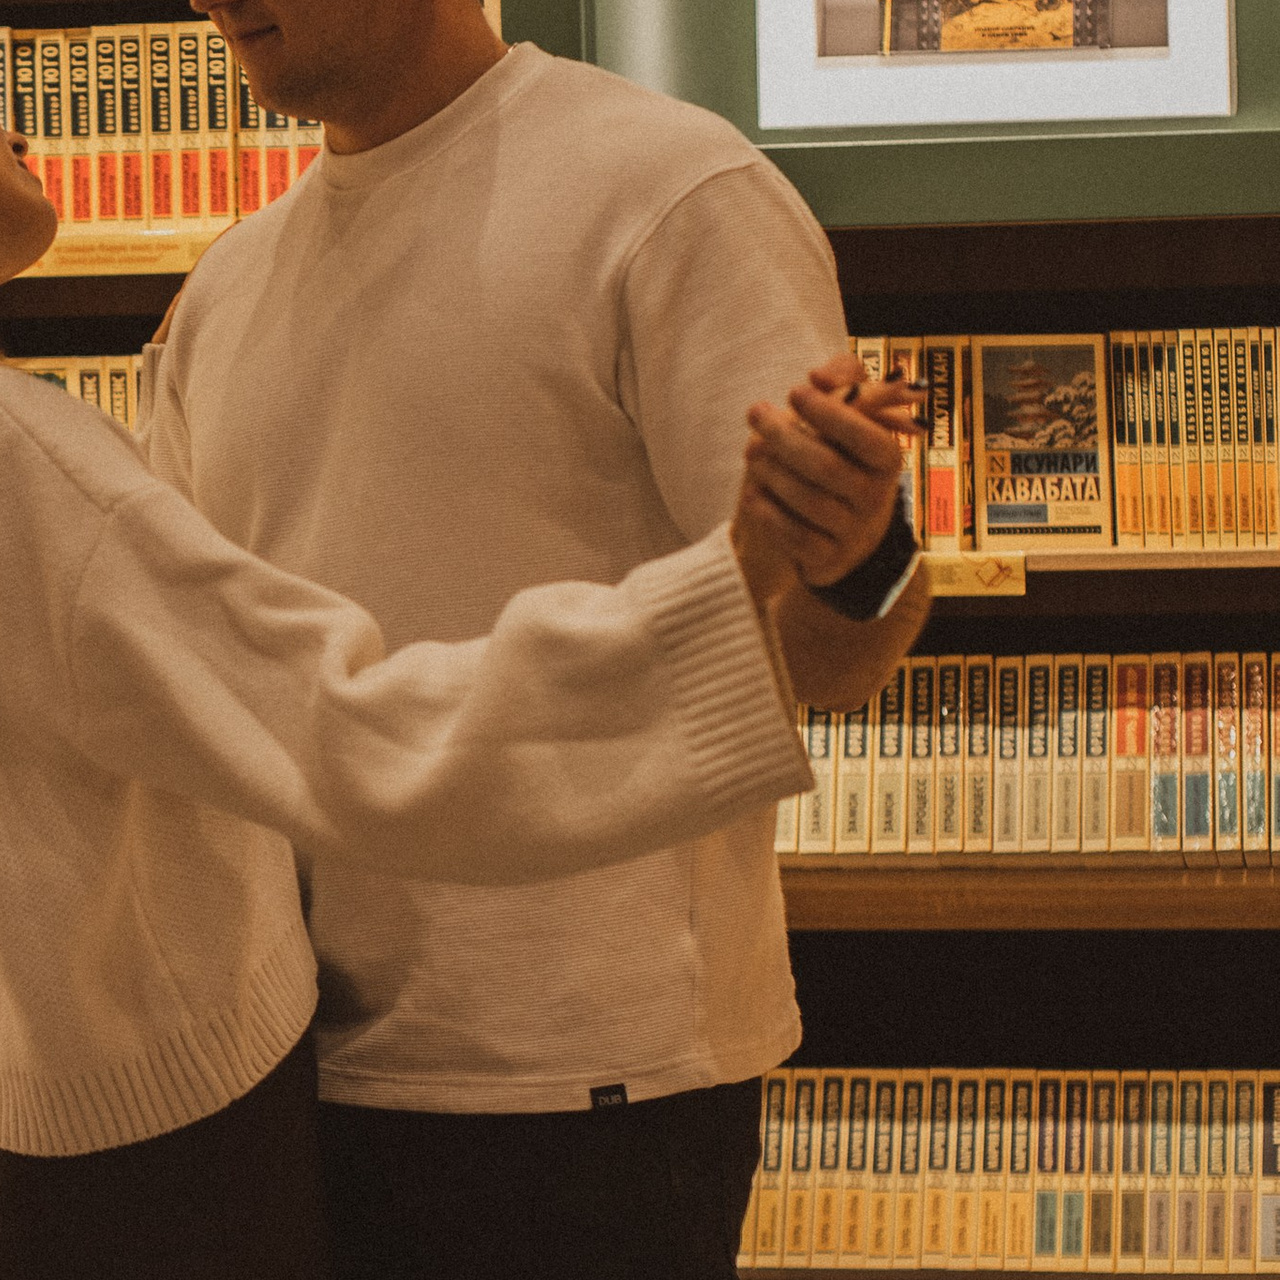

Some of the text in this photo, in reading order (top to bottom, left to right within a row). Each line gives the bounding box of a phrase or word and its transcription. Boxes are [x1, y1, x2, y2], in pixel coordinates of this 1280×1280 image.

[16, 46, 33, 93] ГЮГО
[42, 45, 58, 93] ГЮГО
[71, 45, 87, 92] ГЮГО
[97, 42, 113, 90] ГЮГО
[121, 41, 138, 89] ГЮГО
[152, 40, 168, 88] ГЮГО
[933, 351, 950, 448] КИКУТИ КАН
[1184, 346, 1196, 440] АЛЬБЕР КАМЮ
[1201, 346, 1214, 441] АЛЬБЕР КАМЮ
[1219, 345, 1231, 440] АЛЬБЕР КАМЮ
[1235, 345, 1248, 440] АЛЬБЕР КАМЮ
[1011, 452, 1098, 474] ЯСУНАРИ
[986, 477, 1100, 501] КАВАБАТА
[811, 795, 822, 833] ЗАМОК
[848, 793, 858, 833] ЗАМОК
[884, 793, 894, 832] ЗАМОК
[915, 779, 927, 834] ПРОЦЕСС
[944, 777, 955, 833] ПРОЦЕСС
[973, 777, 984, 833] ПРОЦЕСС
